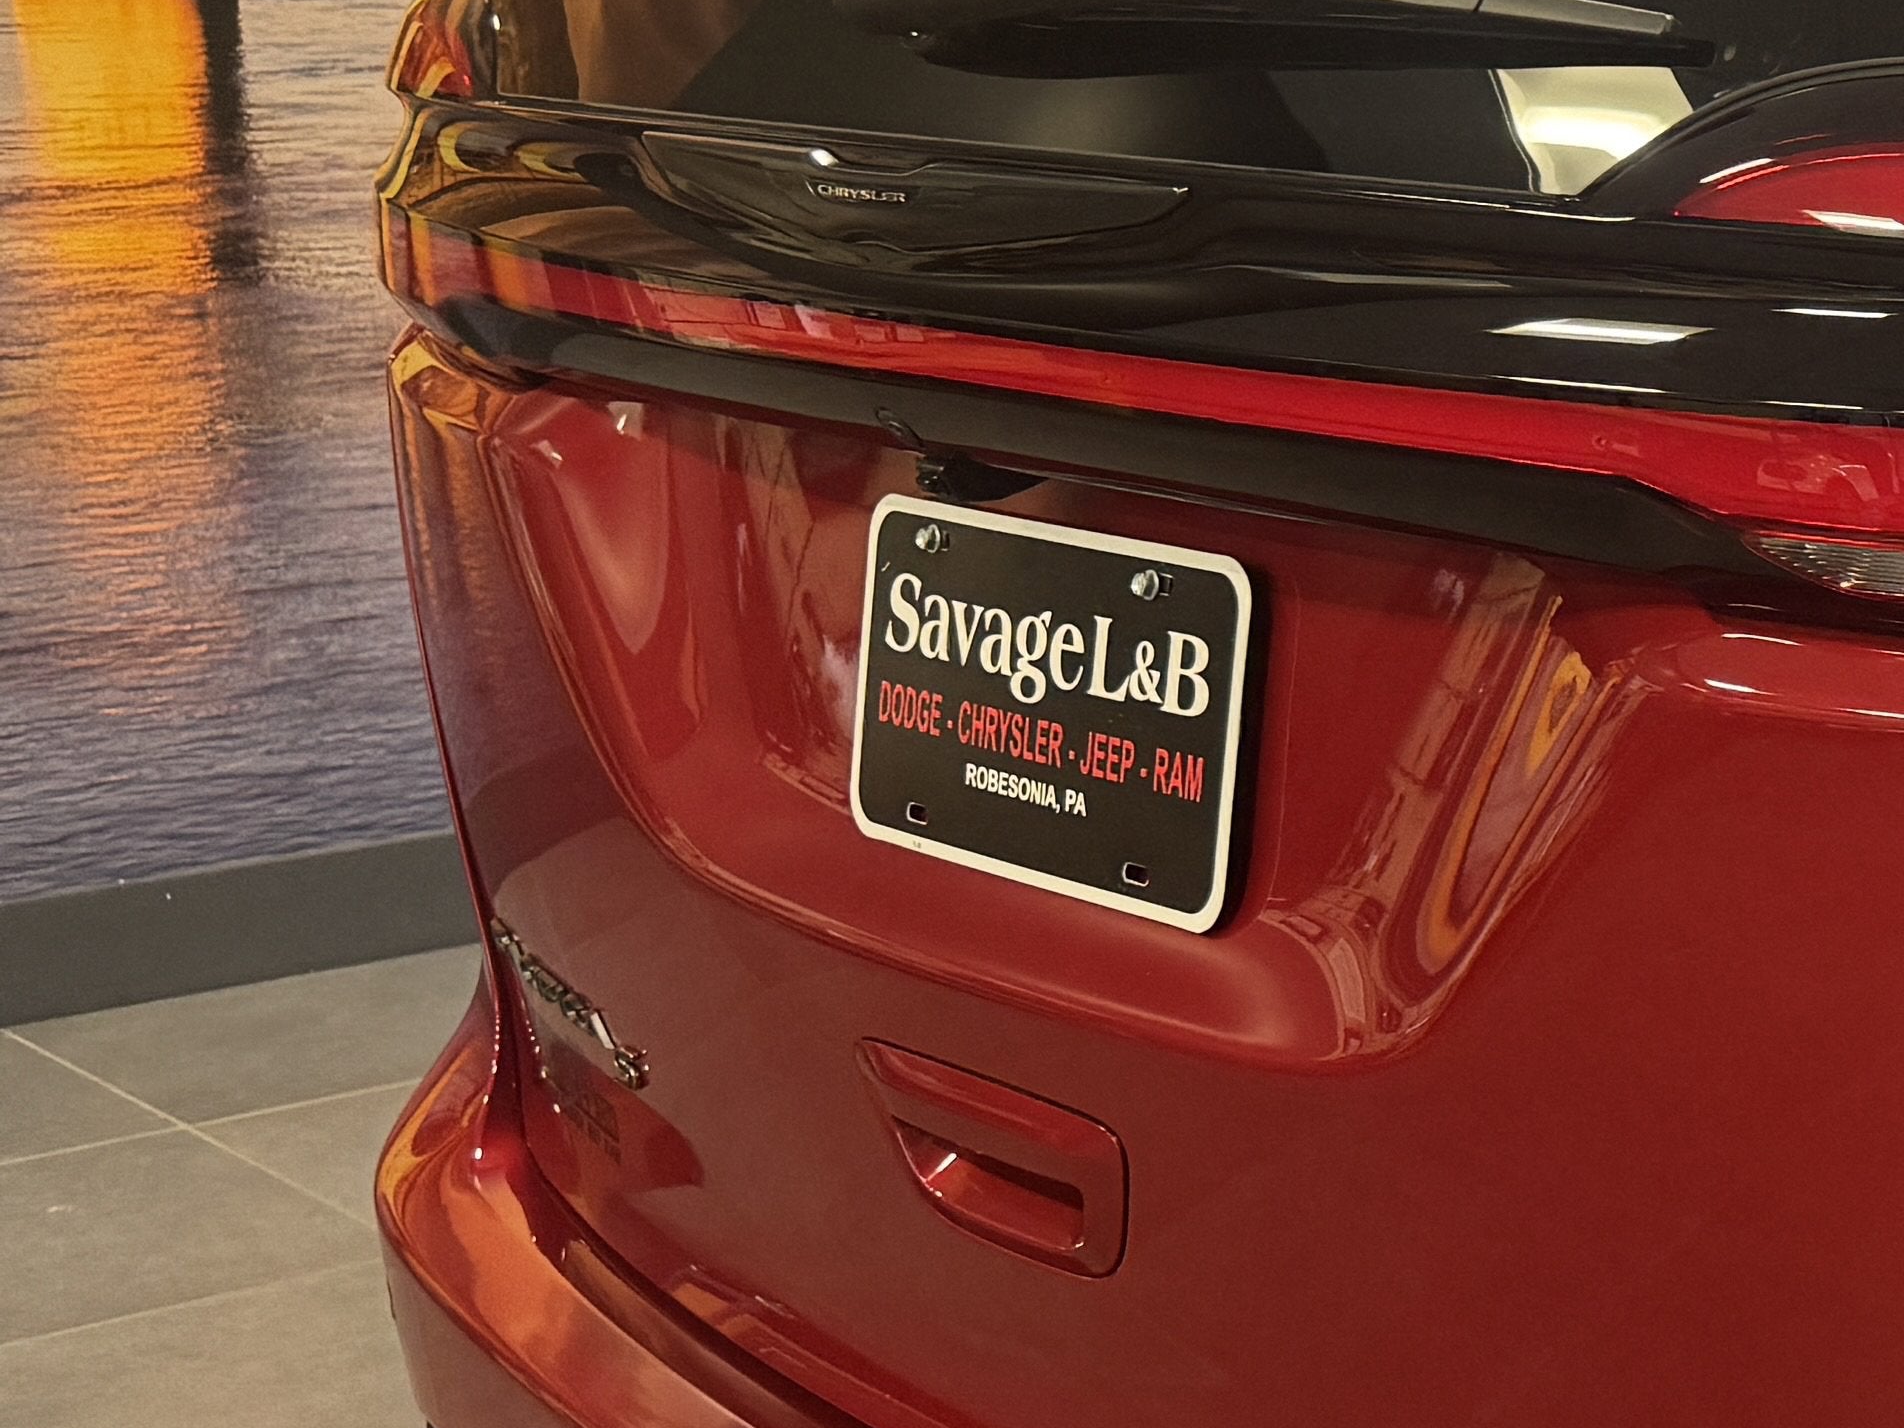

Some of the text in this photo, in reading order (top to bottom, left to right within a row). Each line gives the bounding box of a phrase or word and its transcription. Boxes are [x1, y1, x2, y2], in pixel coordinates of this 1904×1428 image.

[817, 184, 906, 203] CHRYSLER
[878, 679, 943, 737] DODGE
[957, 700, 1063, 769] CHRYSLER
[1078, 731, 1135, 785] JEEP
[1152, 747, 1205, 803] RAM
[965, 763, 1088, 818] ROBESONIA, PA
